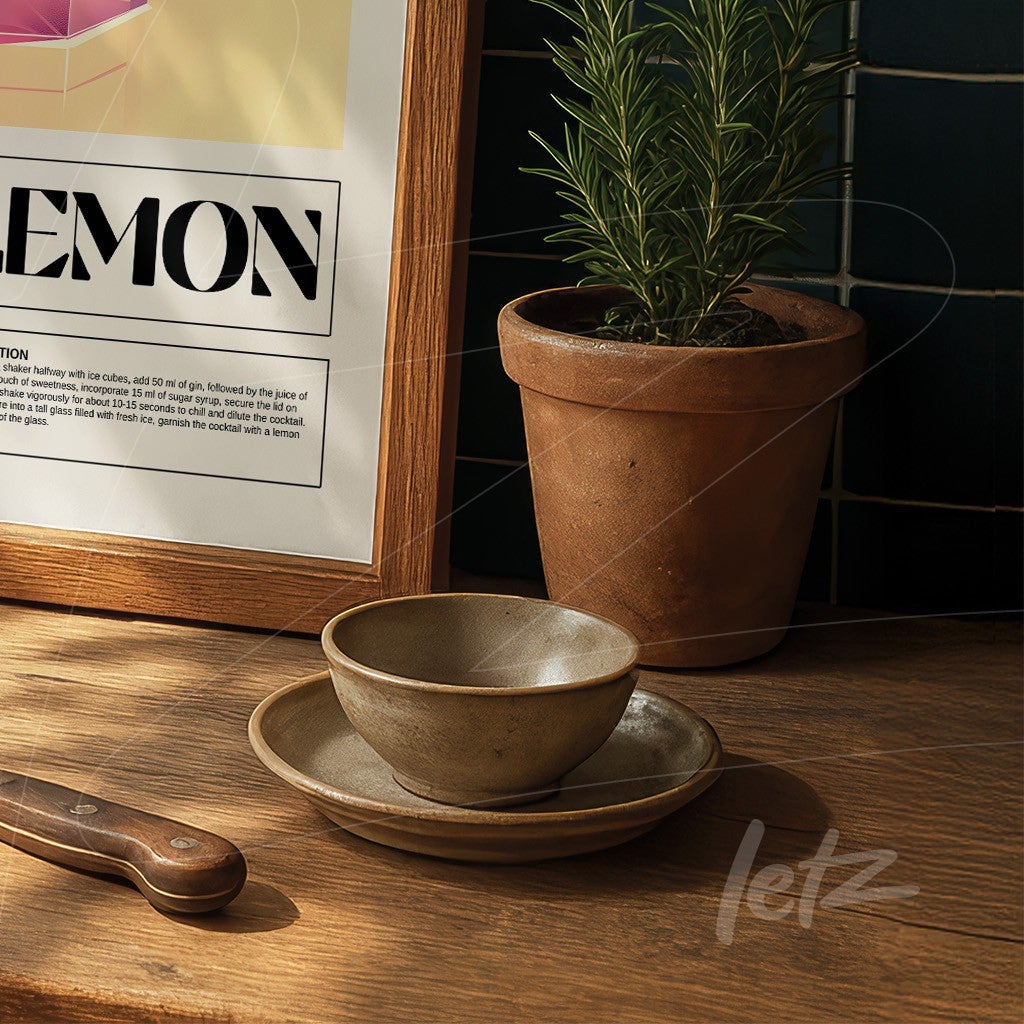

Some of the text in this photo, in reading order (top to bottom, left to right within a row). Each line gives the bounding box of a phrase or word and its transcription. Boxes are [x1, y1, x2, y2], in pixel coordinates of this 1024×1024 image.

[3, 363, 31, 374] shaker
[33, 366, 66, 379] halfway
[68, 369, 85, 379] with
[88, 371, 100, 380] ice
[103, 372, 130, 384] cubes,
[133, 376, 149, 385] add
[152, 378, 163, 386] 50
[166, 379, 176, 388] ml
[178, 380, 187, 388] of
[189, 381, 205, 391] gin,
[208, 383, 243, 395] followed
[246, 386, 257, 397] by
[259, 388, 273, 397] the
[275, 388, 296, 400] juice
[299, 391, 308, 400] of
[21, 378, 29, 386] of
[31, 379, 78, 392] sweetness,
[81, 383, 129, 396] incorporate
[132, 388, 142, 397] 15
[145, 390, 155, 398] ml
[158, 391, 166, 399] of
[168, 393, 192, 403] sugar
[195, 396, 222, 406] syrup,
[225, 399, 254, 408] secure
[257, 401, 271, 410] the
[273, 402, 283, 411] lid
[286, 404, 297, 412] on
[0, 387, 24, 398] shake
[27, 391, 70, 404] vigorously
[72, 394, 82, 404] for
[85, 396, 110, 406] about
[112, 399, 137, 409] 10-15
[139, 402, 175, 413] seconds
[178, 406, 186, 414] to
[189, 406, 206, 416] chill
[208, 408, 225, 418] and
[227, 410, 251, 420] dilute
[253, 413, 267, 422] the
[270, 415, 305, 426] cocktail.
[9, 413, 22, 423] the
[24, 415, 49, 425] glass.
[10, 400, 25, 410] into
[35, 404, 48, 413] tall
[50, 406, 72, 416] glass
[74, 407, 94, 418] filled
[97, 409, 114, 420] with
[116, 413, 138, 422] fresh
[140, 414, 155, 425] ice,
[158, 416, 190, 427] garnish
[192, 419, 206, 429] the
[209, 421, 242, 433] cocktail
[244, 424, 262, 435] with
[273, 427, 299, 439] lemon
